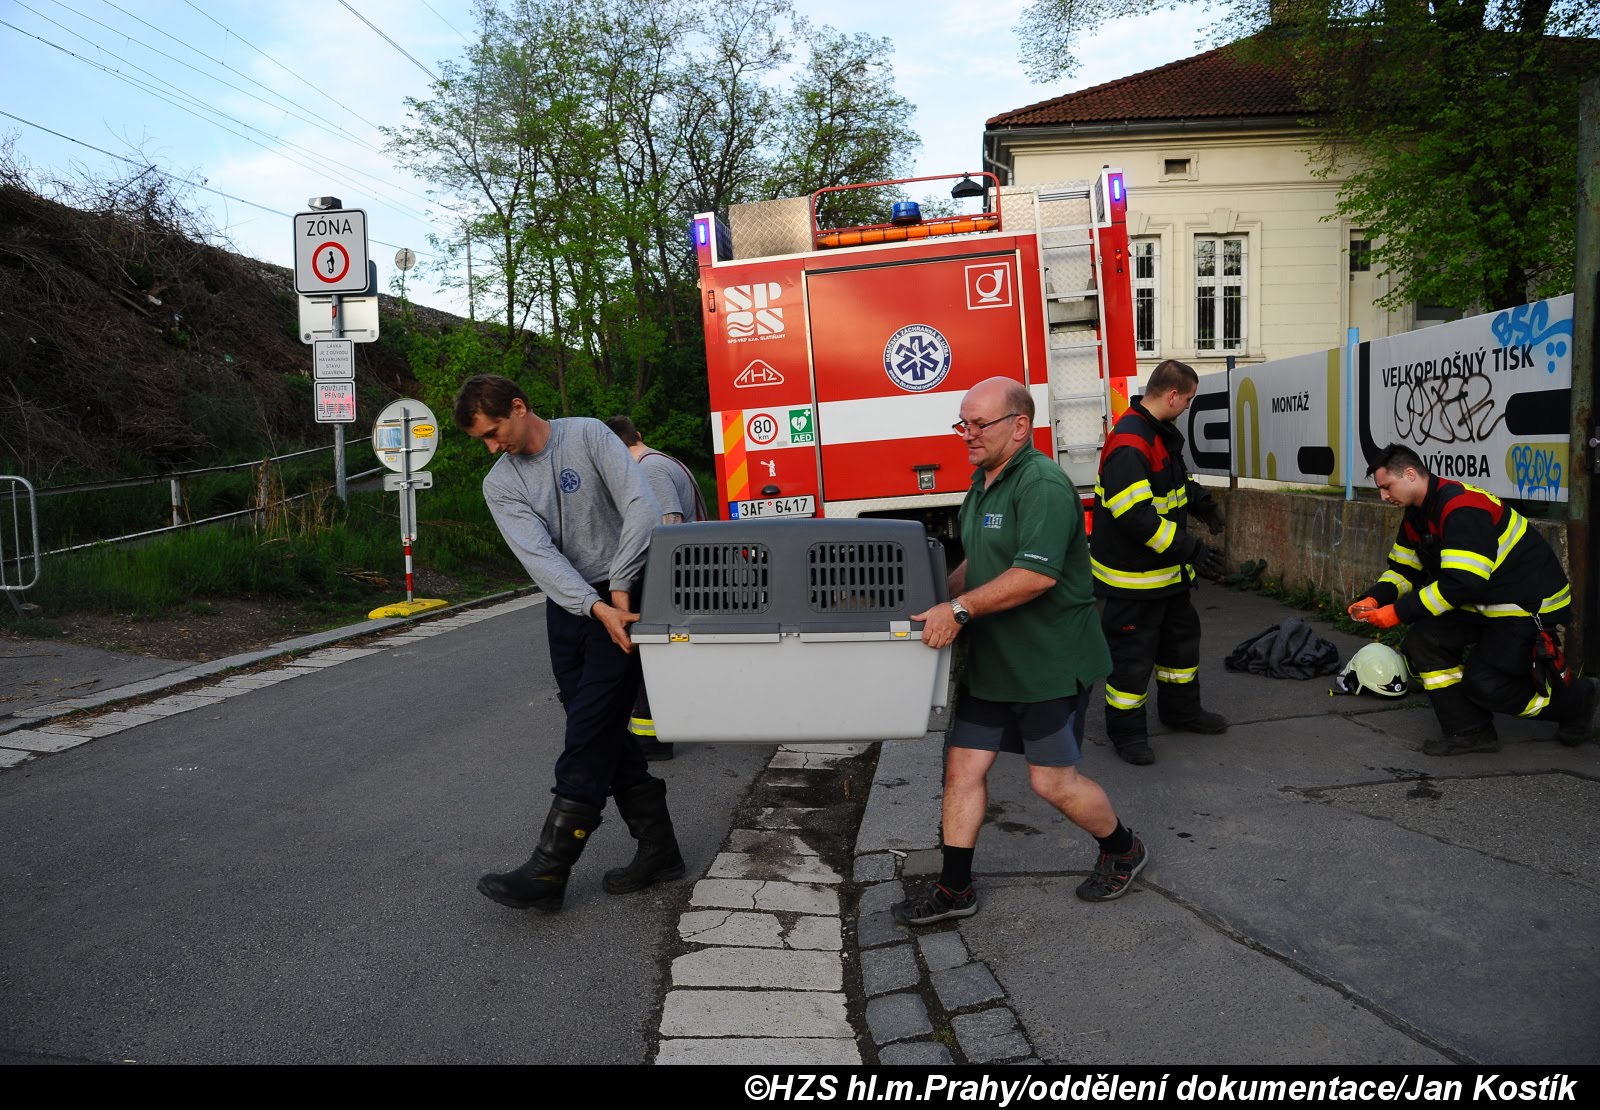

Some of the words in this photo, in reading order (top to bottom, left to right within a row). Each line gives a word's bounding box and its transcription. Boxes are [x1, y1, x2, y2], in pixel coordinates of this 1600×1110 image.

[307, 216, 353, 237] ZÓNA
[900, 325, 937, 337] ZÁCHRANNÁ
[936, 335, 950, 358] SLUŽBA
[1382, 347, 1487, 388] VELKOPLOŠNÝ
[1492, 343, 1535, 372] TISK
[1272, 391, 1310, 414] MONTÁŽ
[753, 419, 772, 434] 80
[793, 433, 812, 443] AED
[1423, 451, 1491, 478] VÝROBA
[741, 502, 765, 517] 3AF
[775, 498, 808, 514] 6417
